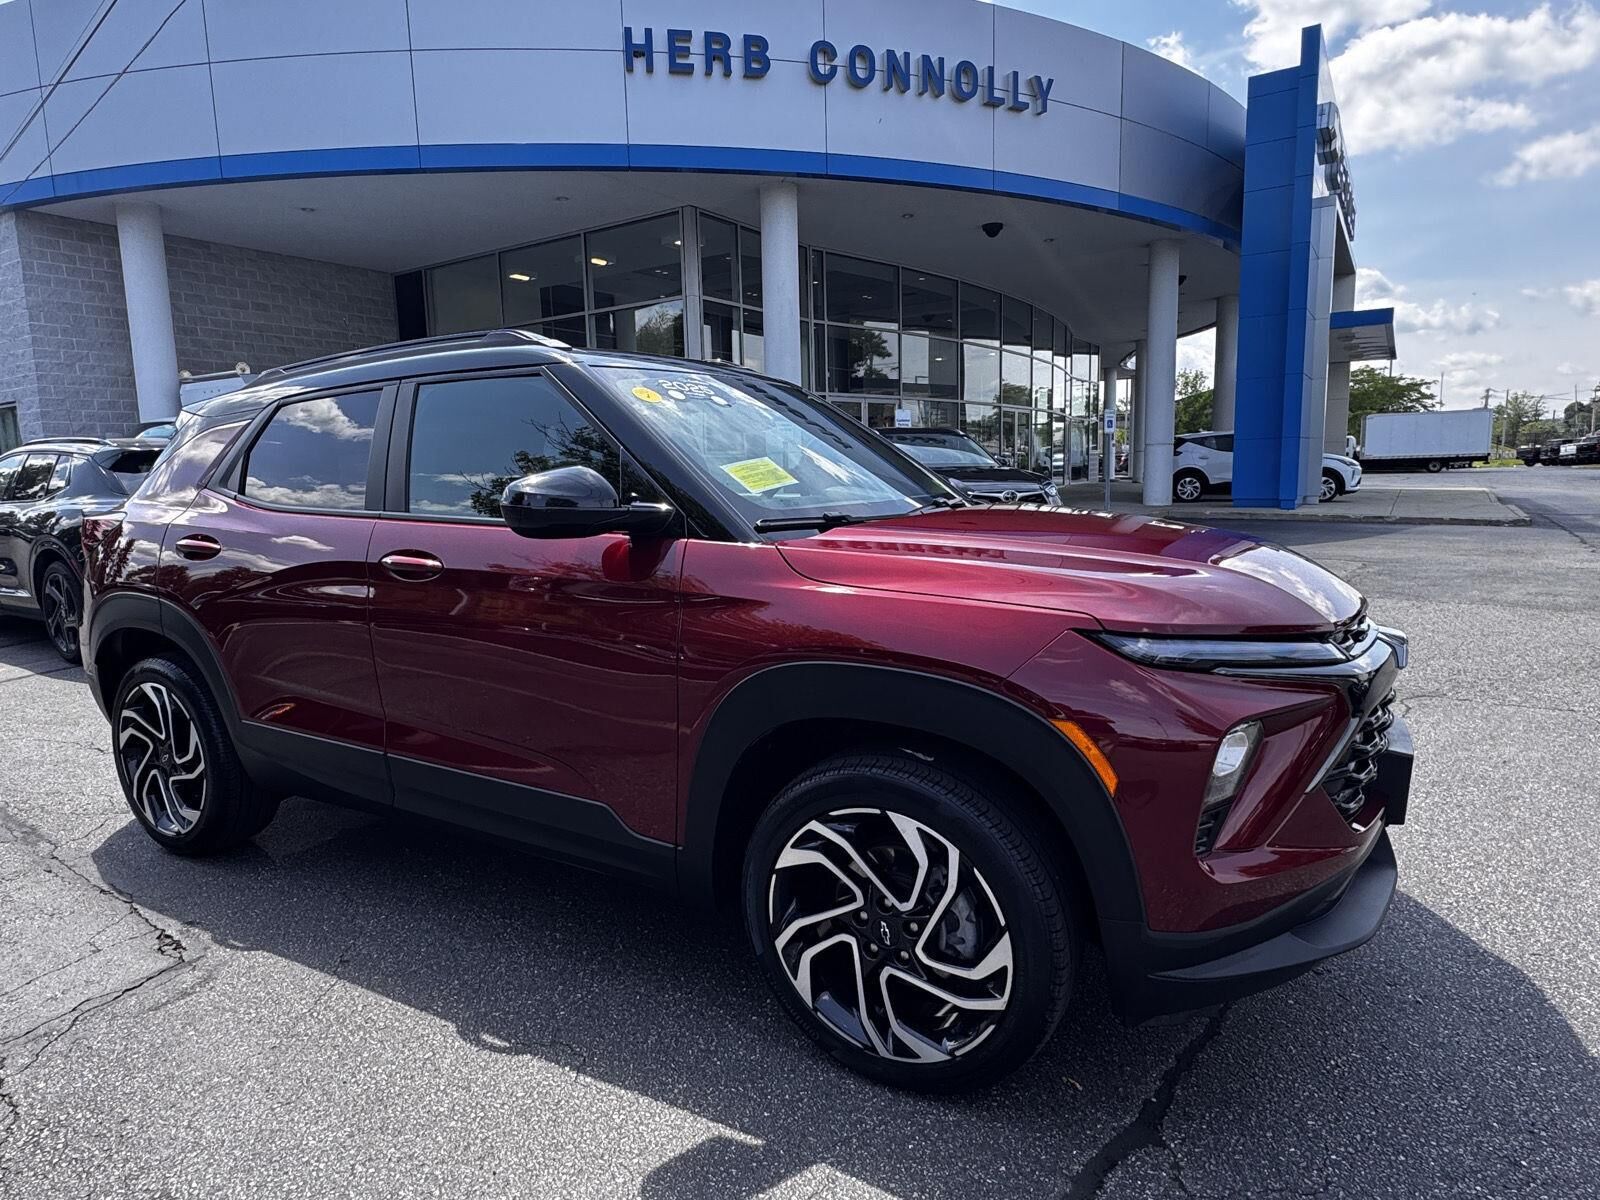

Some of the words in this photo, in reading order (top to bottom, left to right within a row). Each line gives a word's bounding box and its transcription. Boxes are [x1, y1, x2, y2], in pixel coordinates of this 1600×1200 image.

[623, 27, 771, 79] HERB
[808, 40, 1054, 116] CONNOLLY
[658, 379, 715, 395] 2025
